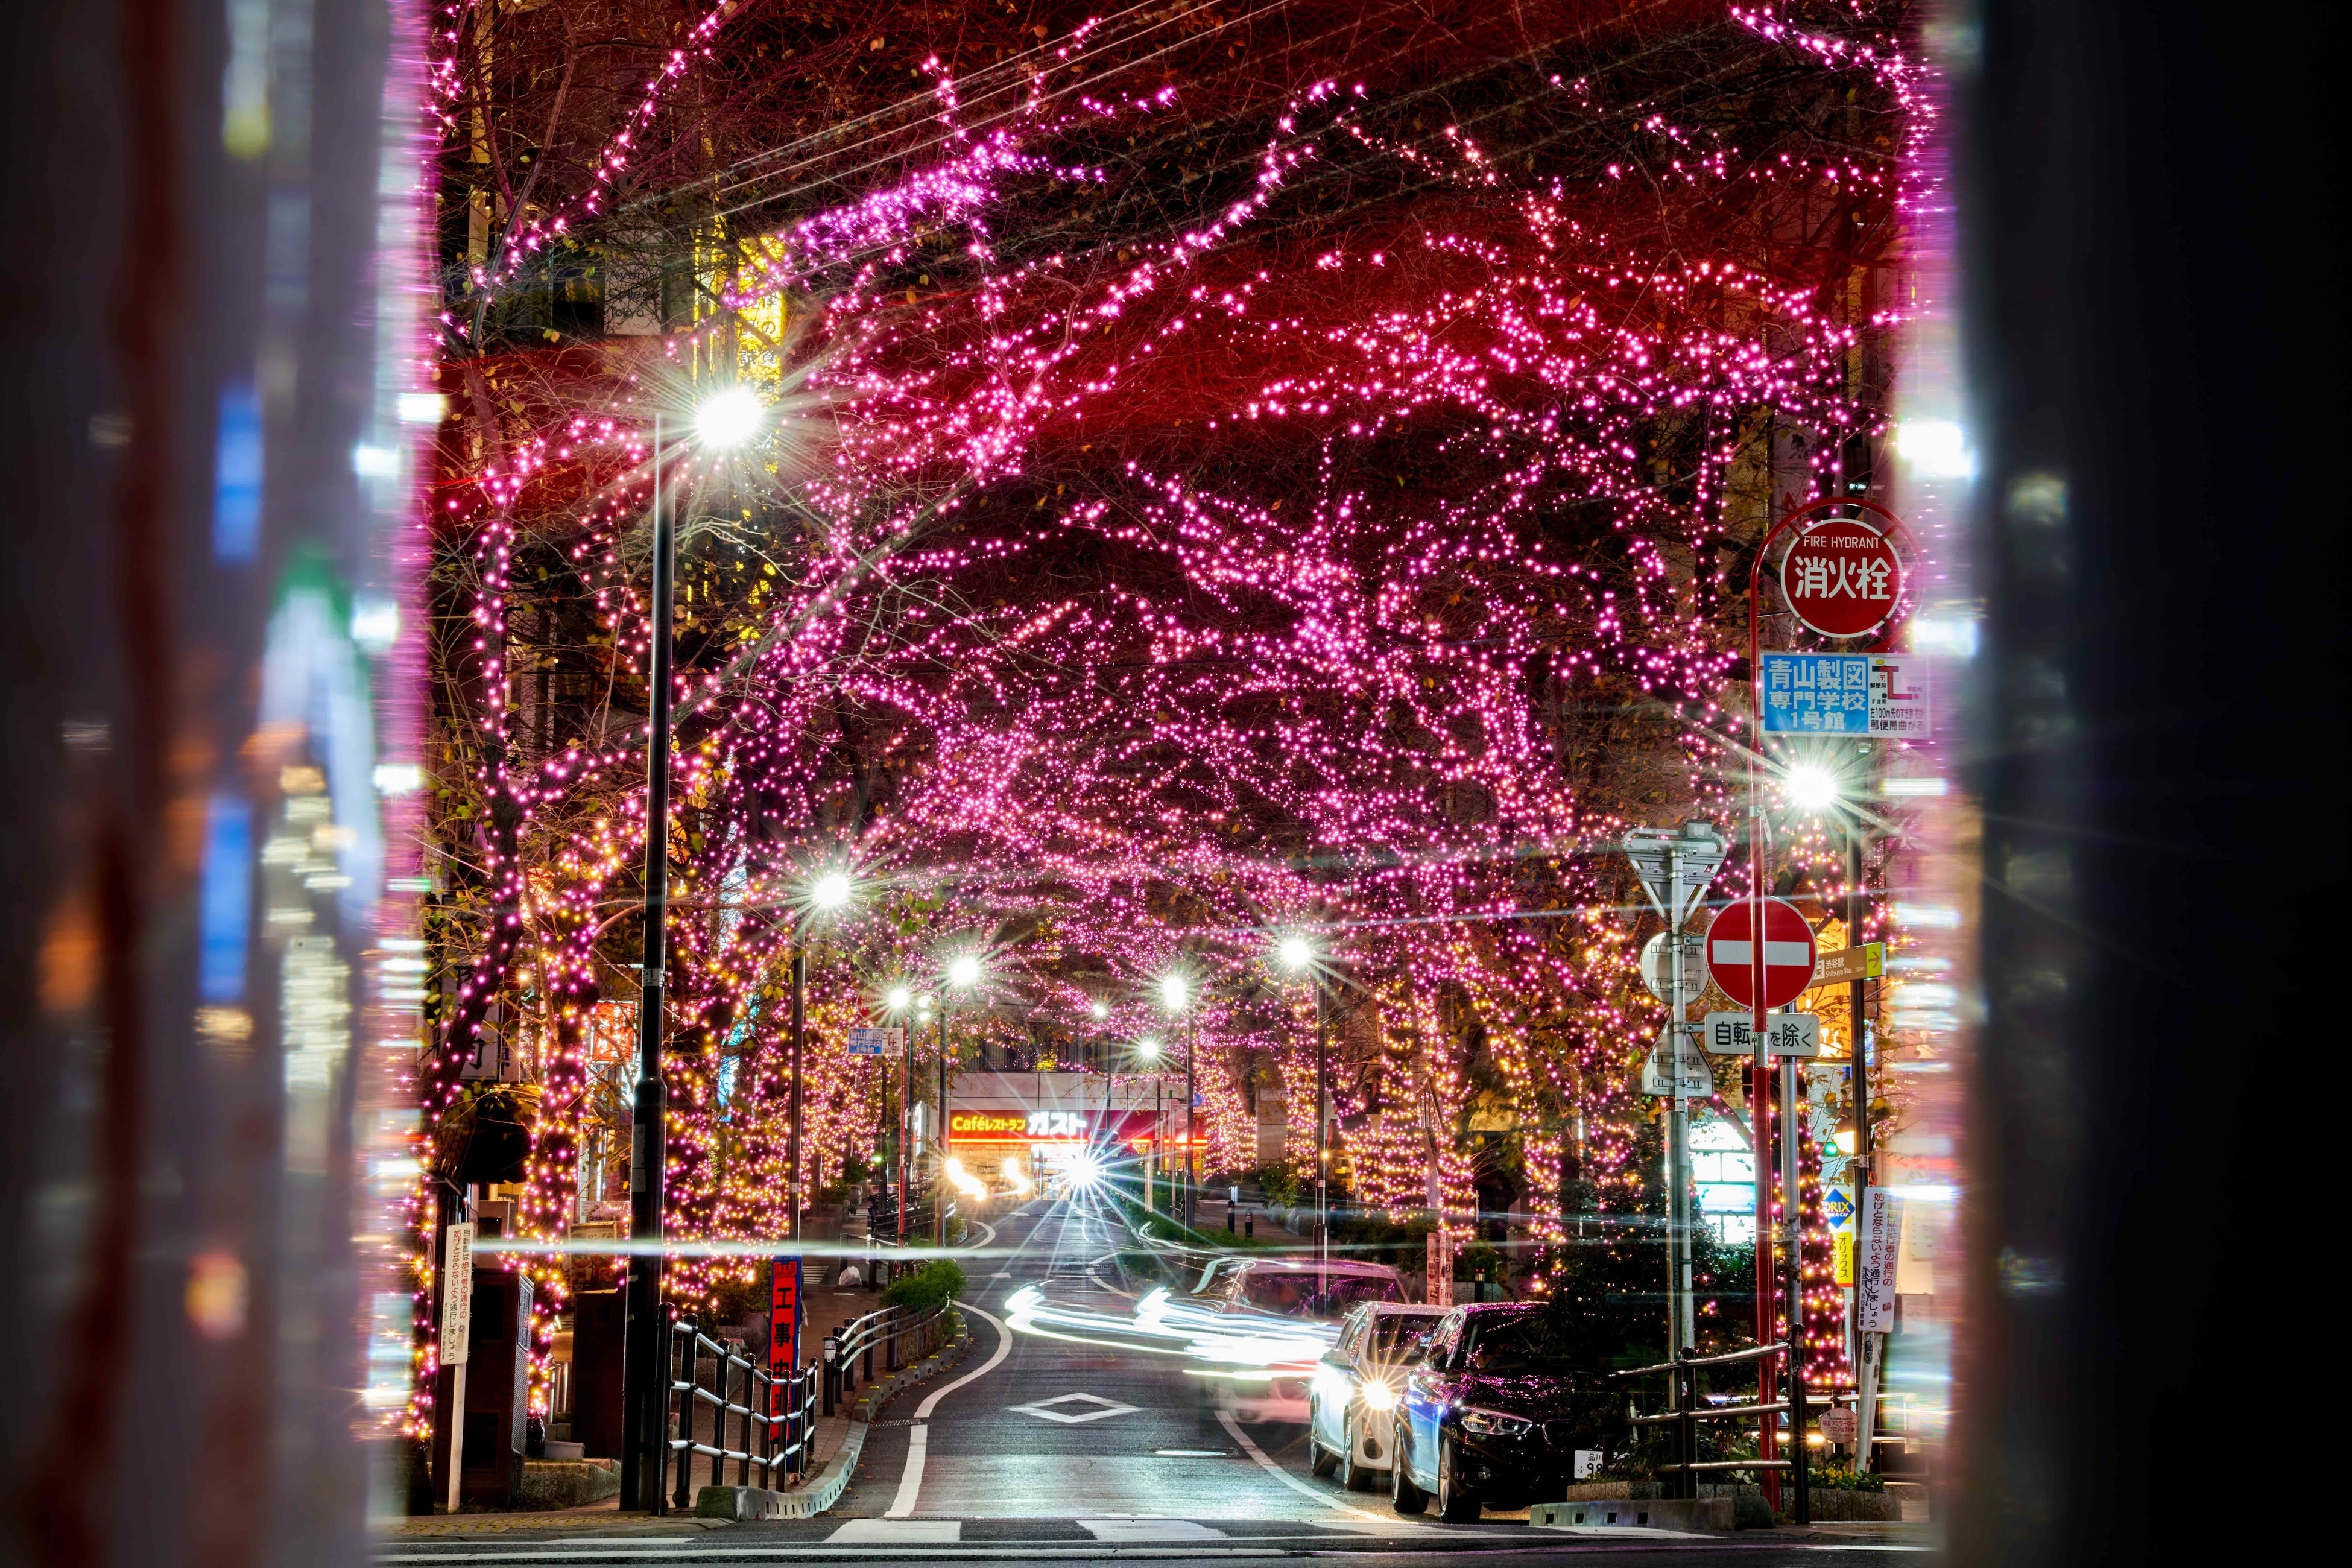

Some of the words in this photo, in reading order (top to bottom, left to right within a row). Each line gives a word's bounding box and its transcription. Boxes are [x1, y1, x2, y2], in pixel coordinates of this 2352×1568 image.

[1804, 536, 1827, 548] FIRE
[1831, 536, 1879, 549] HYDRANT
[1795, 556, 1891, 600] 消火栓
[1768, 660, 1867, 691] 青山製図
[1769, 691, 1865, 712] 専門学校
[1791, 711, 1845, 730] 1号館
[1870, 719, 1924, 730] 郵便局曲がる
[1826, 957, 1844, 969] 渋谷駅
[1826, 968, 1844, 978] Shibuya
[1716, 1022, 1812, 1048] 自転を除く
[1028, 1111, 1087, 1136] ガスト
[1838, 1236, 1848, 1278] オリックス
[1868, 1192, 1885, 1328] 妨げとならないよう通行しましょう
[459, 1229, 471, 1319] 自転車は歩行者の通行の
[447, 1230, 461, 1361] 妨げとならないよう通行しましょう
